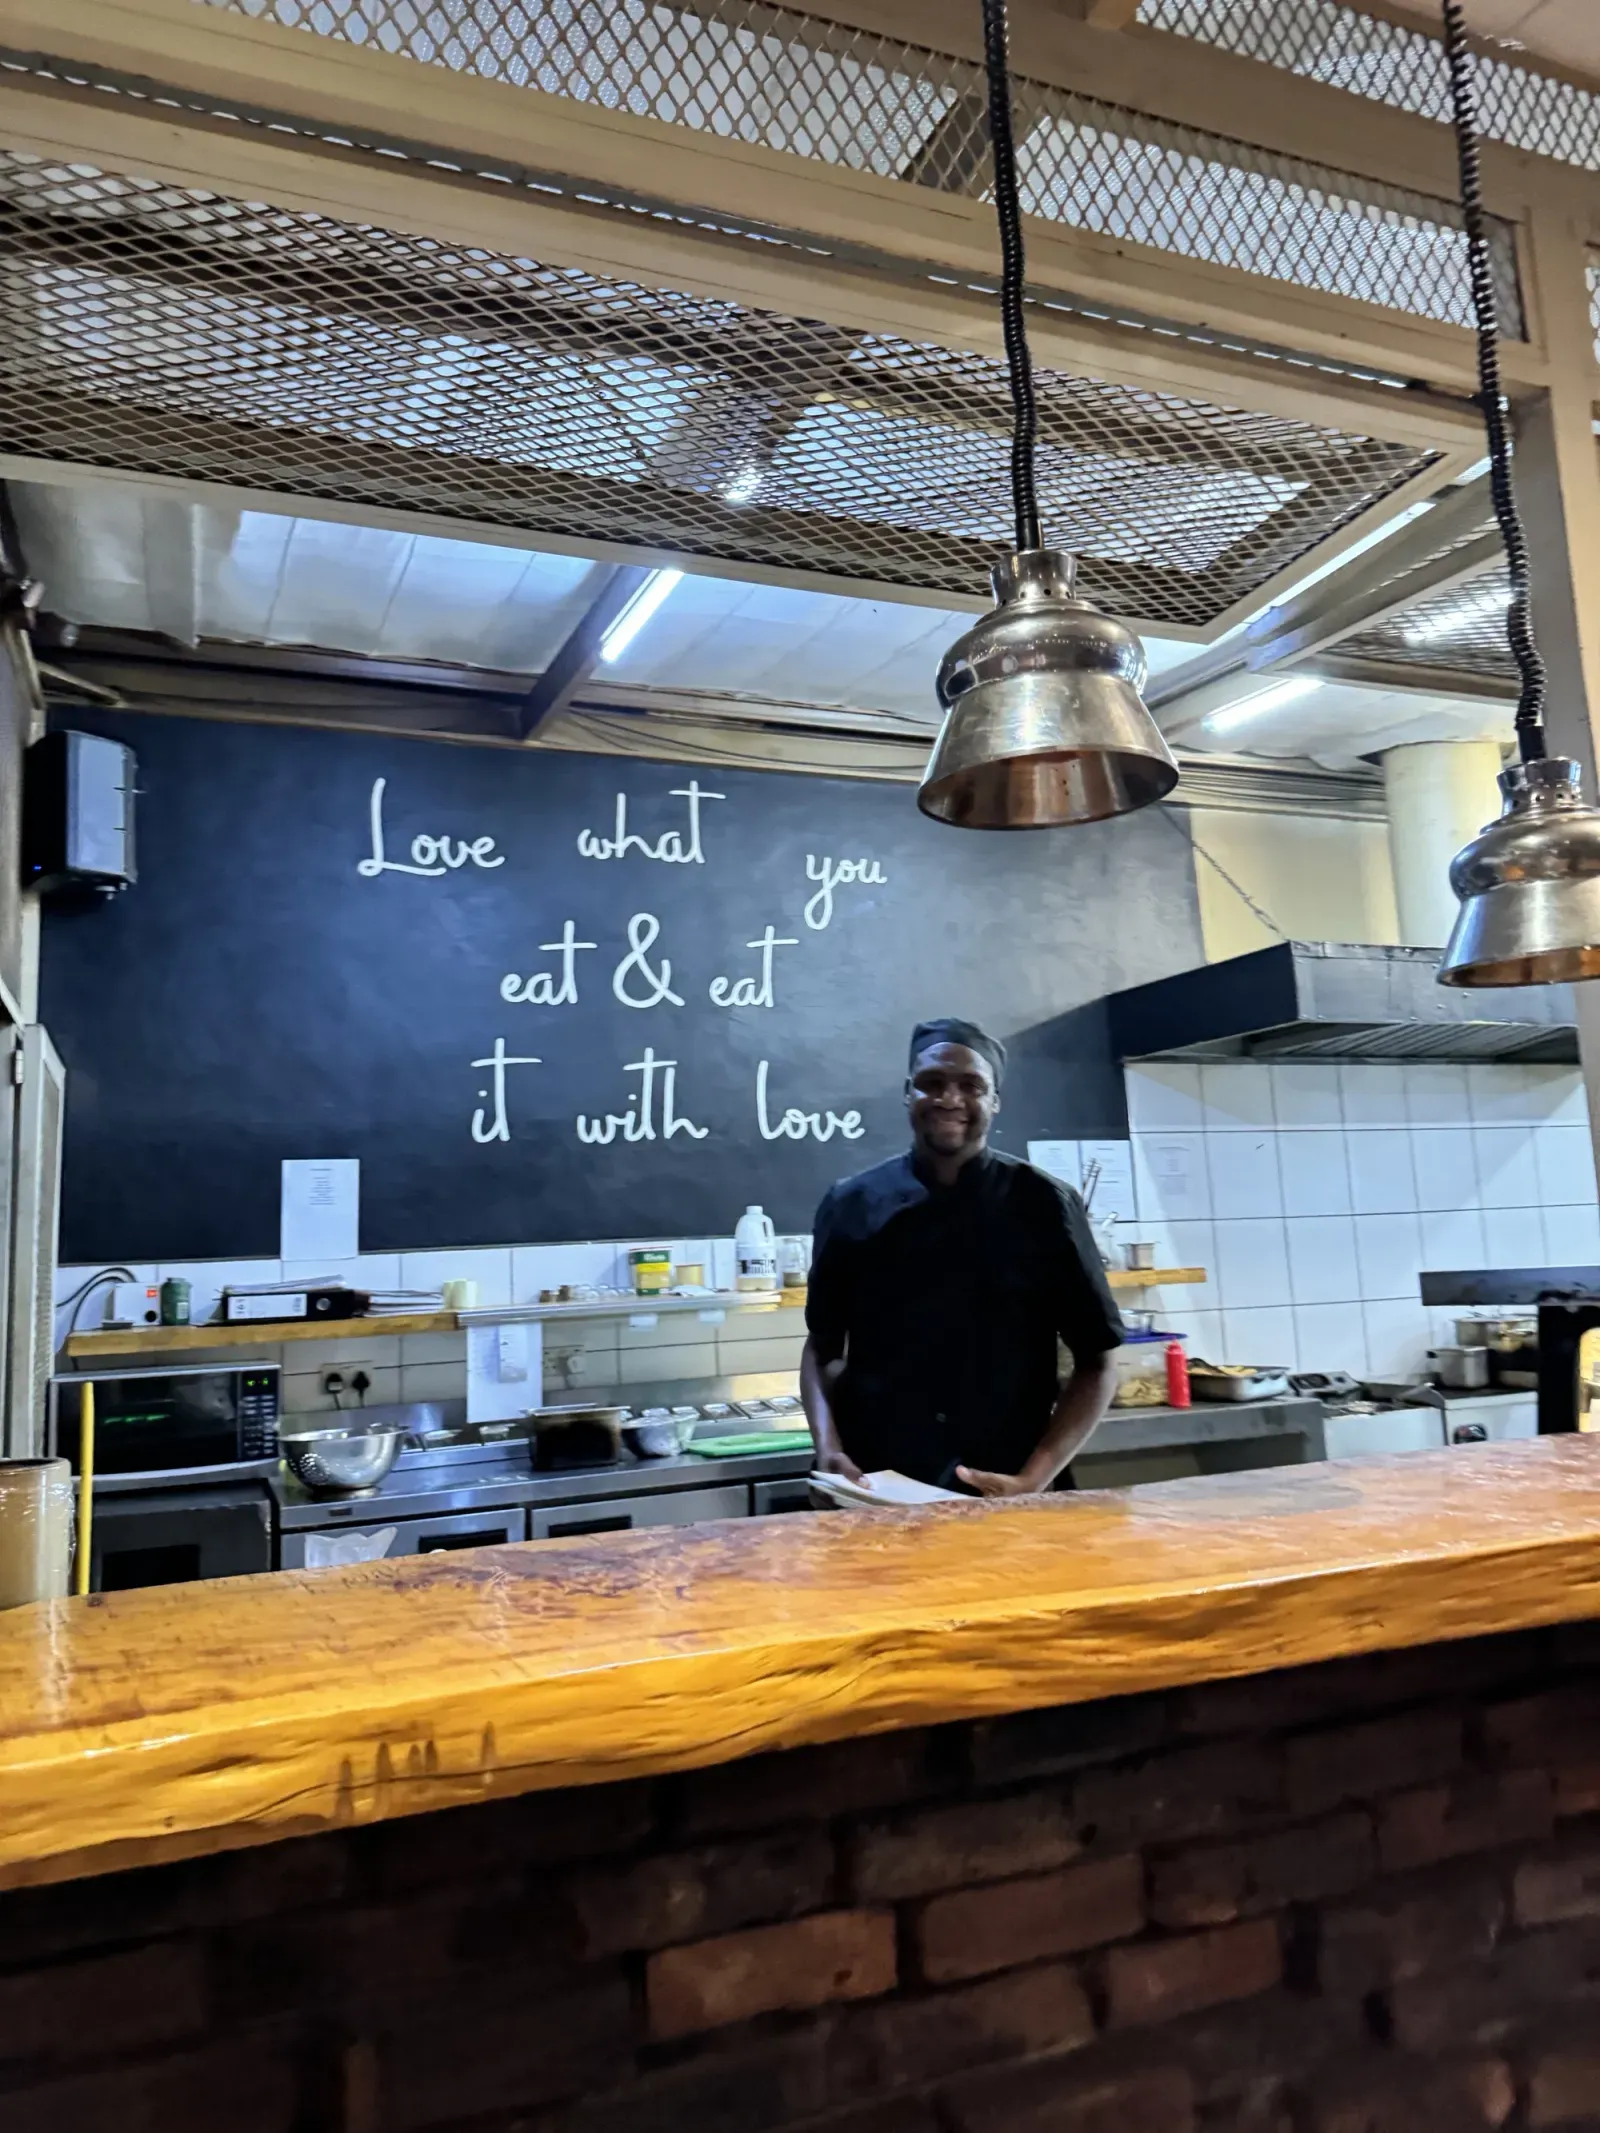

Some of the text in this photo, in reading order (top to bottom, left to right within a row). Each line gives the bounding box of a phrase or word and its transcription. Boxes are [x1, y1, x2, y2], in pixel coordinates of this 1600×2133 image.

[357, 777, 887, 930] Love what you
[500, 913, 799, 1008] eat & eat
[470, 1038, 865, 1143] it with love
